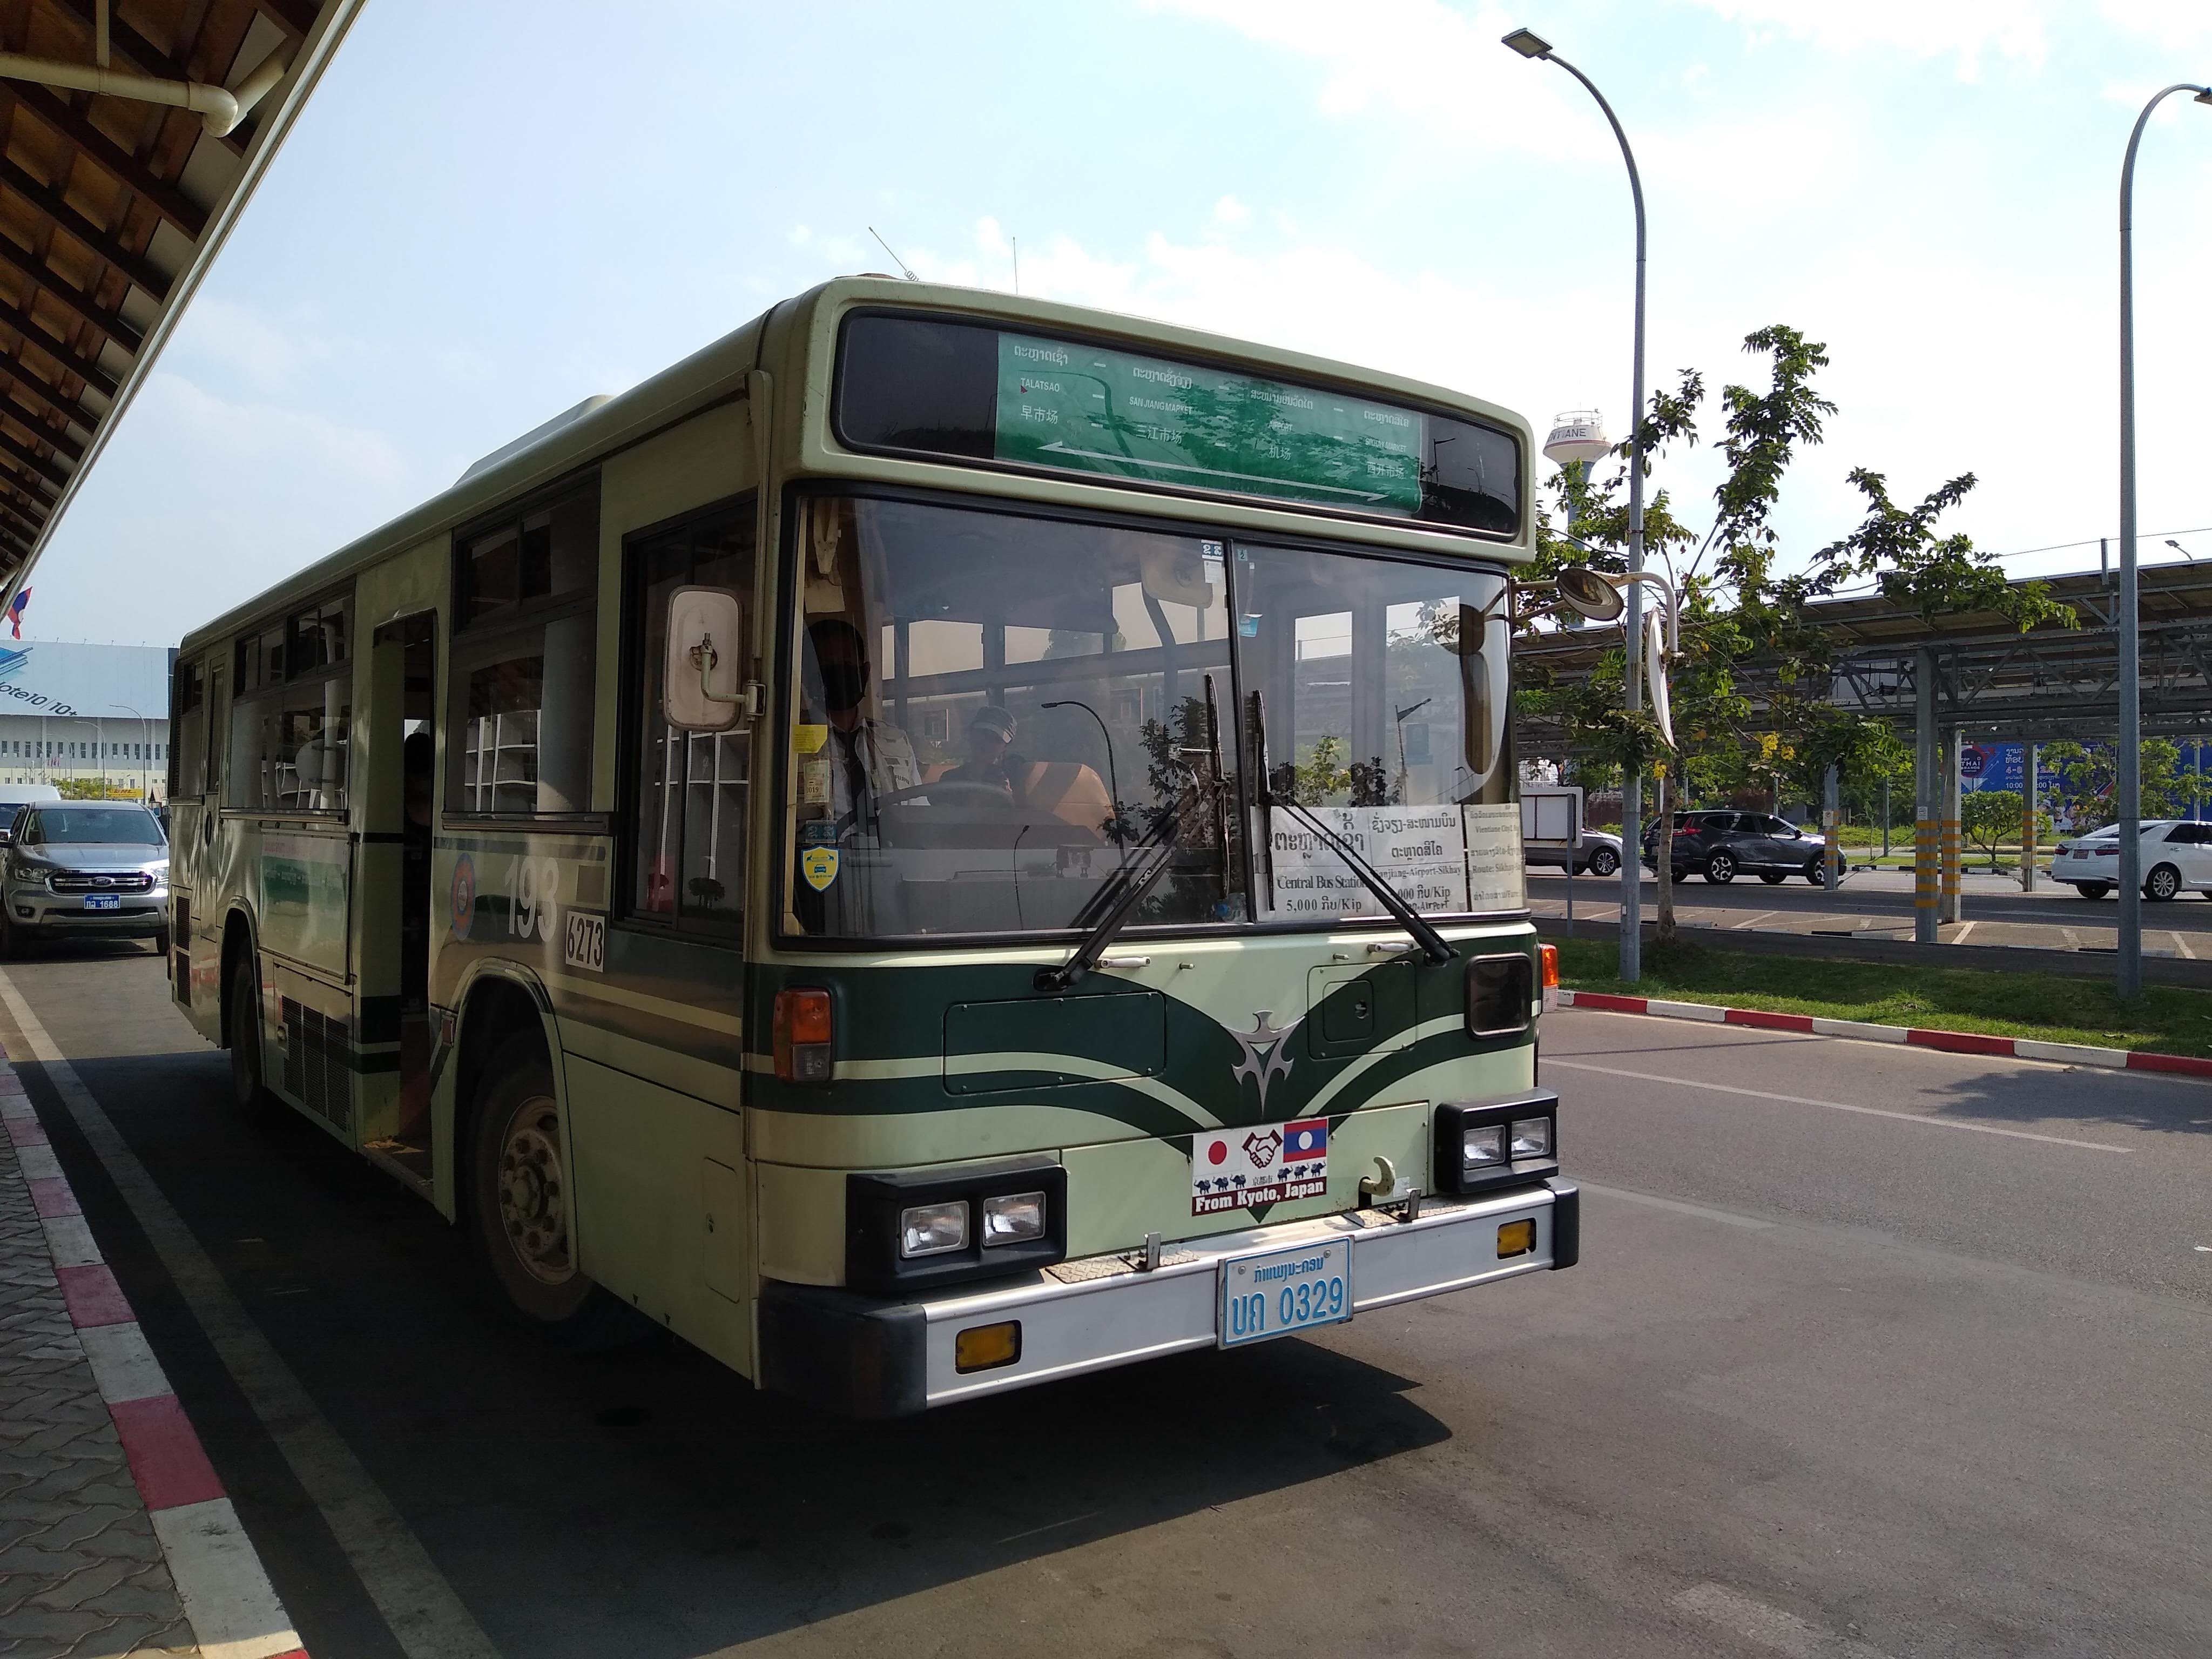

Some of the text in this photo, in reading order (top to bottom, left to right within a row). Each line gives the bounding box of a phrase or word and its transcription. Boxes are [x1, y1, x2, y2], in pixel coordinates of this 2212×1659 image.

[1021, 377, 1060, 392] TALATSAO
[1129, 396, 1143, 407] SAN
[1144, 400, 1164, 410] JIANG
[1165, 403, 1193, 415] MARKET
[1269, 420, 1293, 432] AIRPORT
[1385, 442, 1406, 453] MARKET
[1021, 404, 1058, 424] 早市场
[1136, 424, 1182, 444] 三江市场
[1269, 445, 1292, 461] 机场
[1277, 875, 1313, 889] Central
[1317, 875, 1333, 888] Bus
[1375, 865, 1461, 880] anjiang-Airport-Sikhay
[505, 854, 559, 942] 193
[1286, 899, 1318, 913] 5,000
[567, 915, 603, 967] 6273
[1195, 1181, 1324, 1213] From Kyoto, Japan
[1252, 1175, 1273, 1186] 京都市
[1279, 1275, 1343, 1325] 0329
